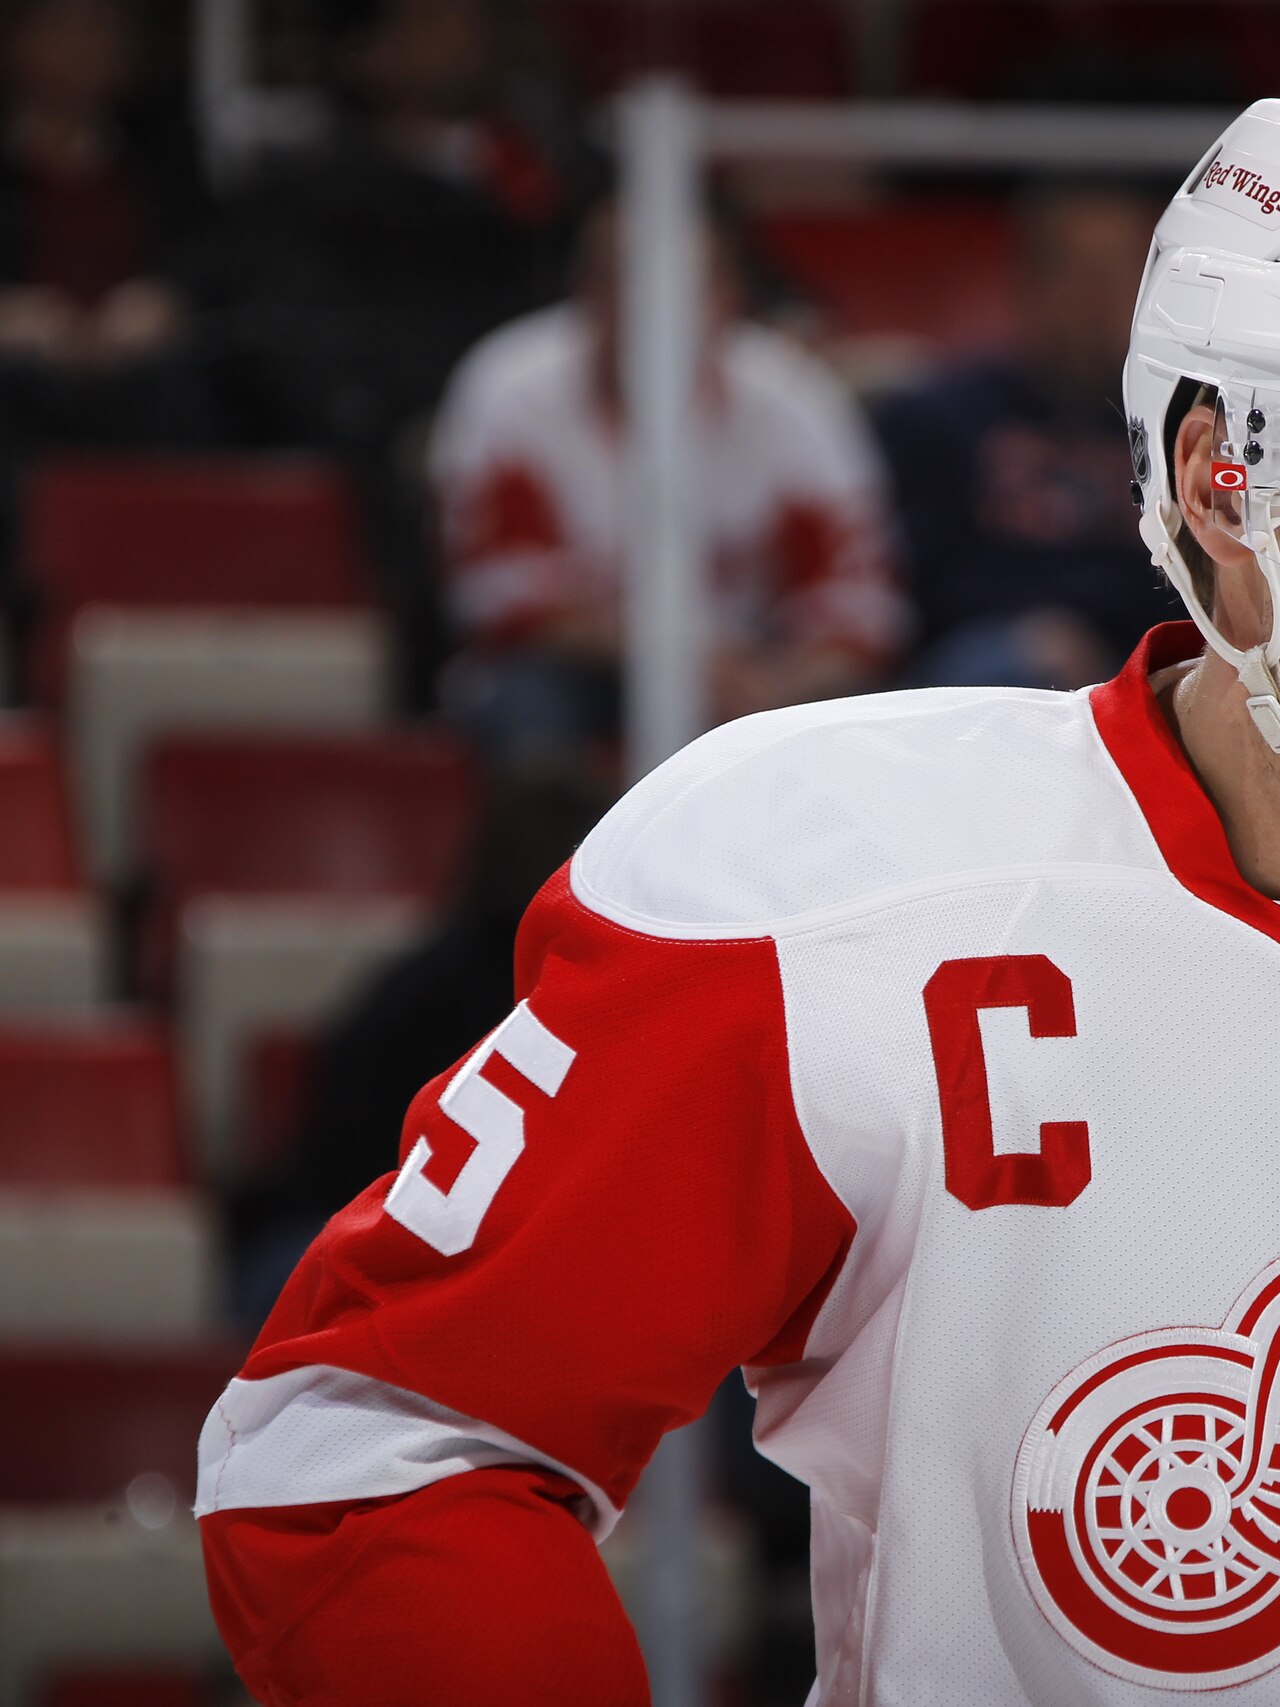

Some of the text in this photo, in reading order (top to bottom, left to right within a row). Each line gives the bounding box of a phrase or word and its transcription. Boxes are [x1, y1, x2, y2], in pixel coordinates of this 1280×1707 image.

[1204, 161, 1235, 189] Red
[383, 999, 577, 1257] 5
[923, 954, 1092, 1211] C
